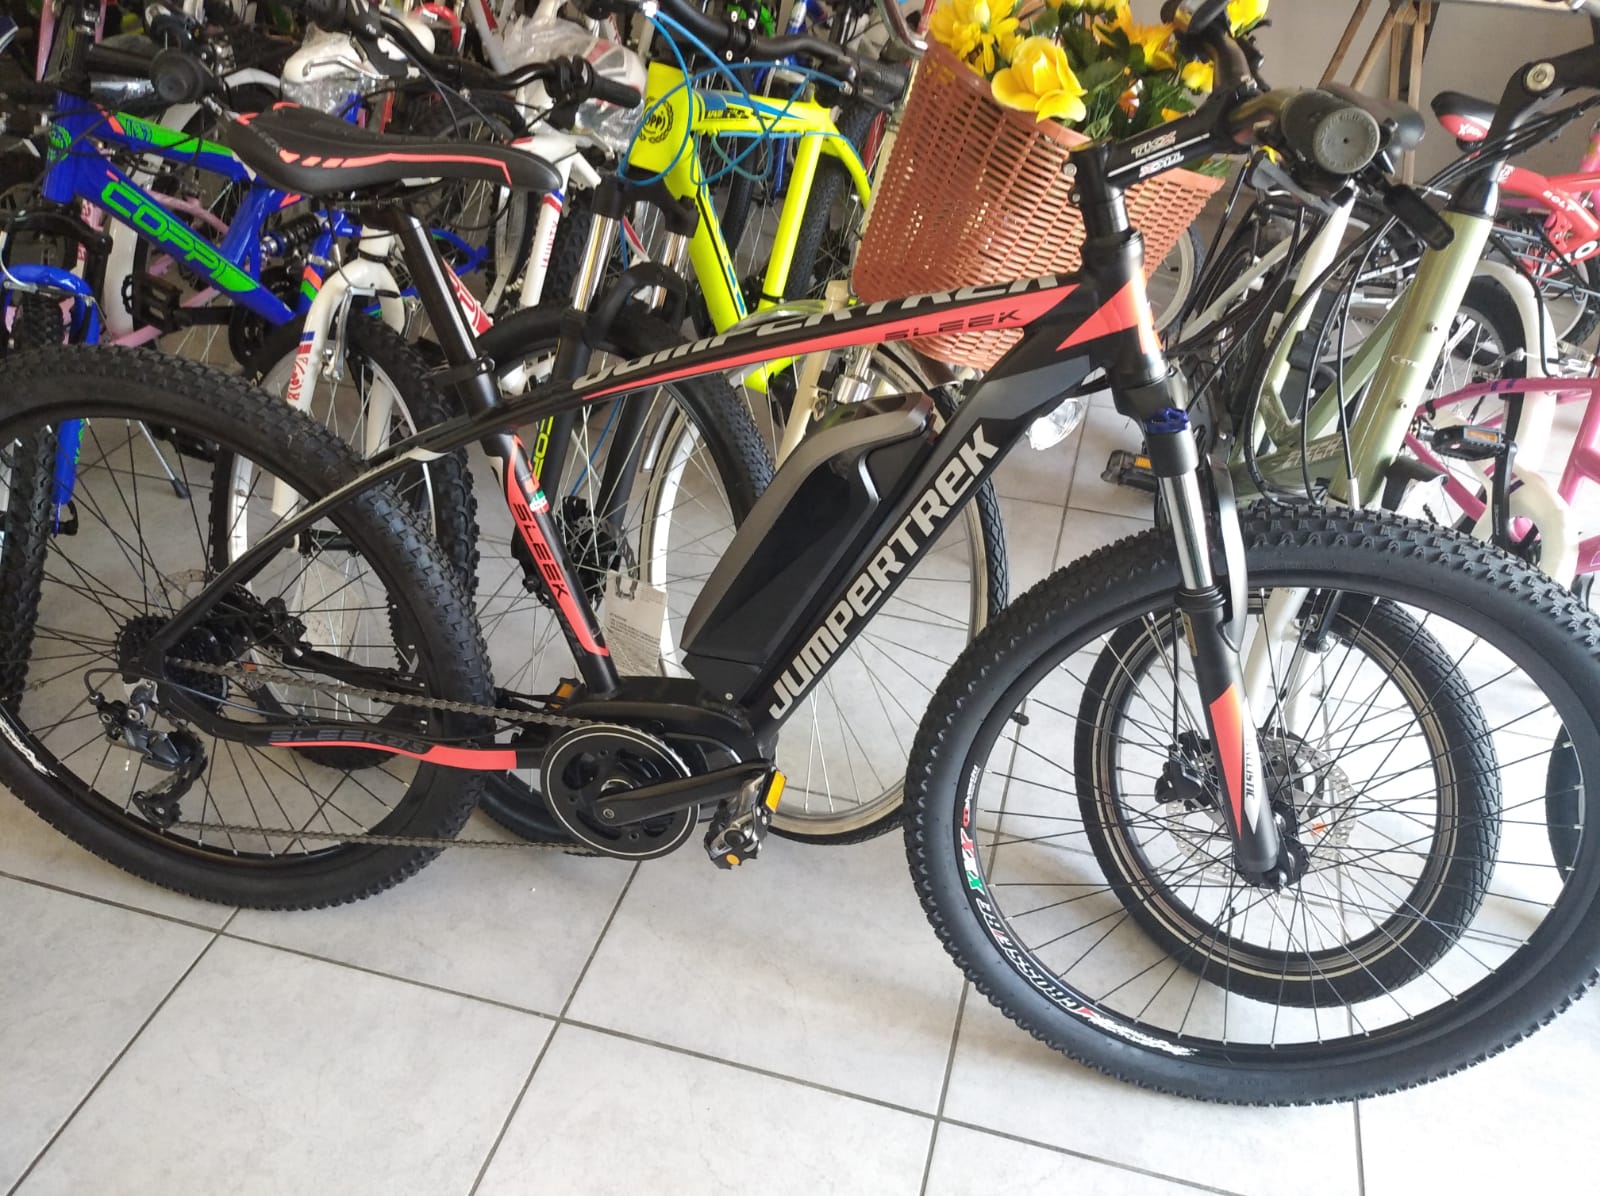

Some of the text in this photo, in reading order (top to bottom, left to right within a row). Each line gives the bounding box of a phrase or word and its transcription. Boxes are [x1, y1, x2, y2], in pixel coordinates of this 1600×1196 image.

[101, 181, 226, 280] COPPI
[884, 309, 1021, 342] SLEEK
[513, 503, 569, 598] SLEEK
[269, 729, 382, 744] SLEEK
[1245, 738, 1255, 800] LLISTIC
